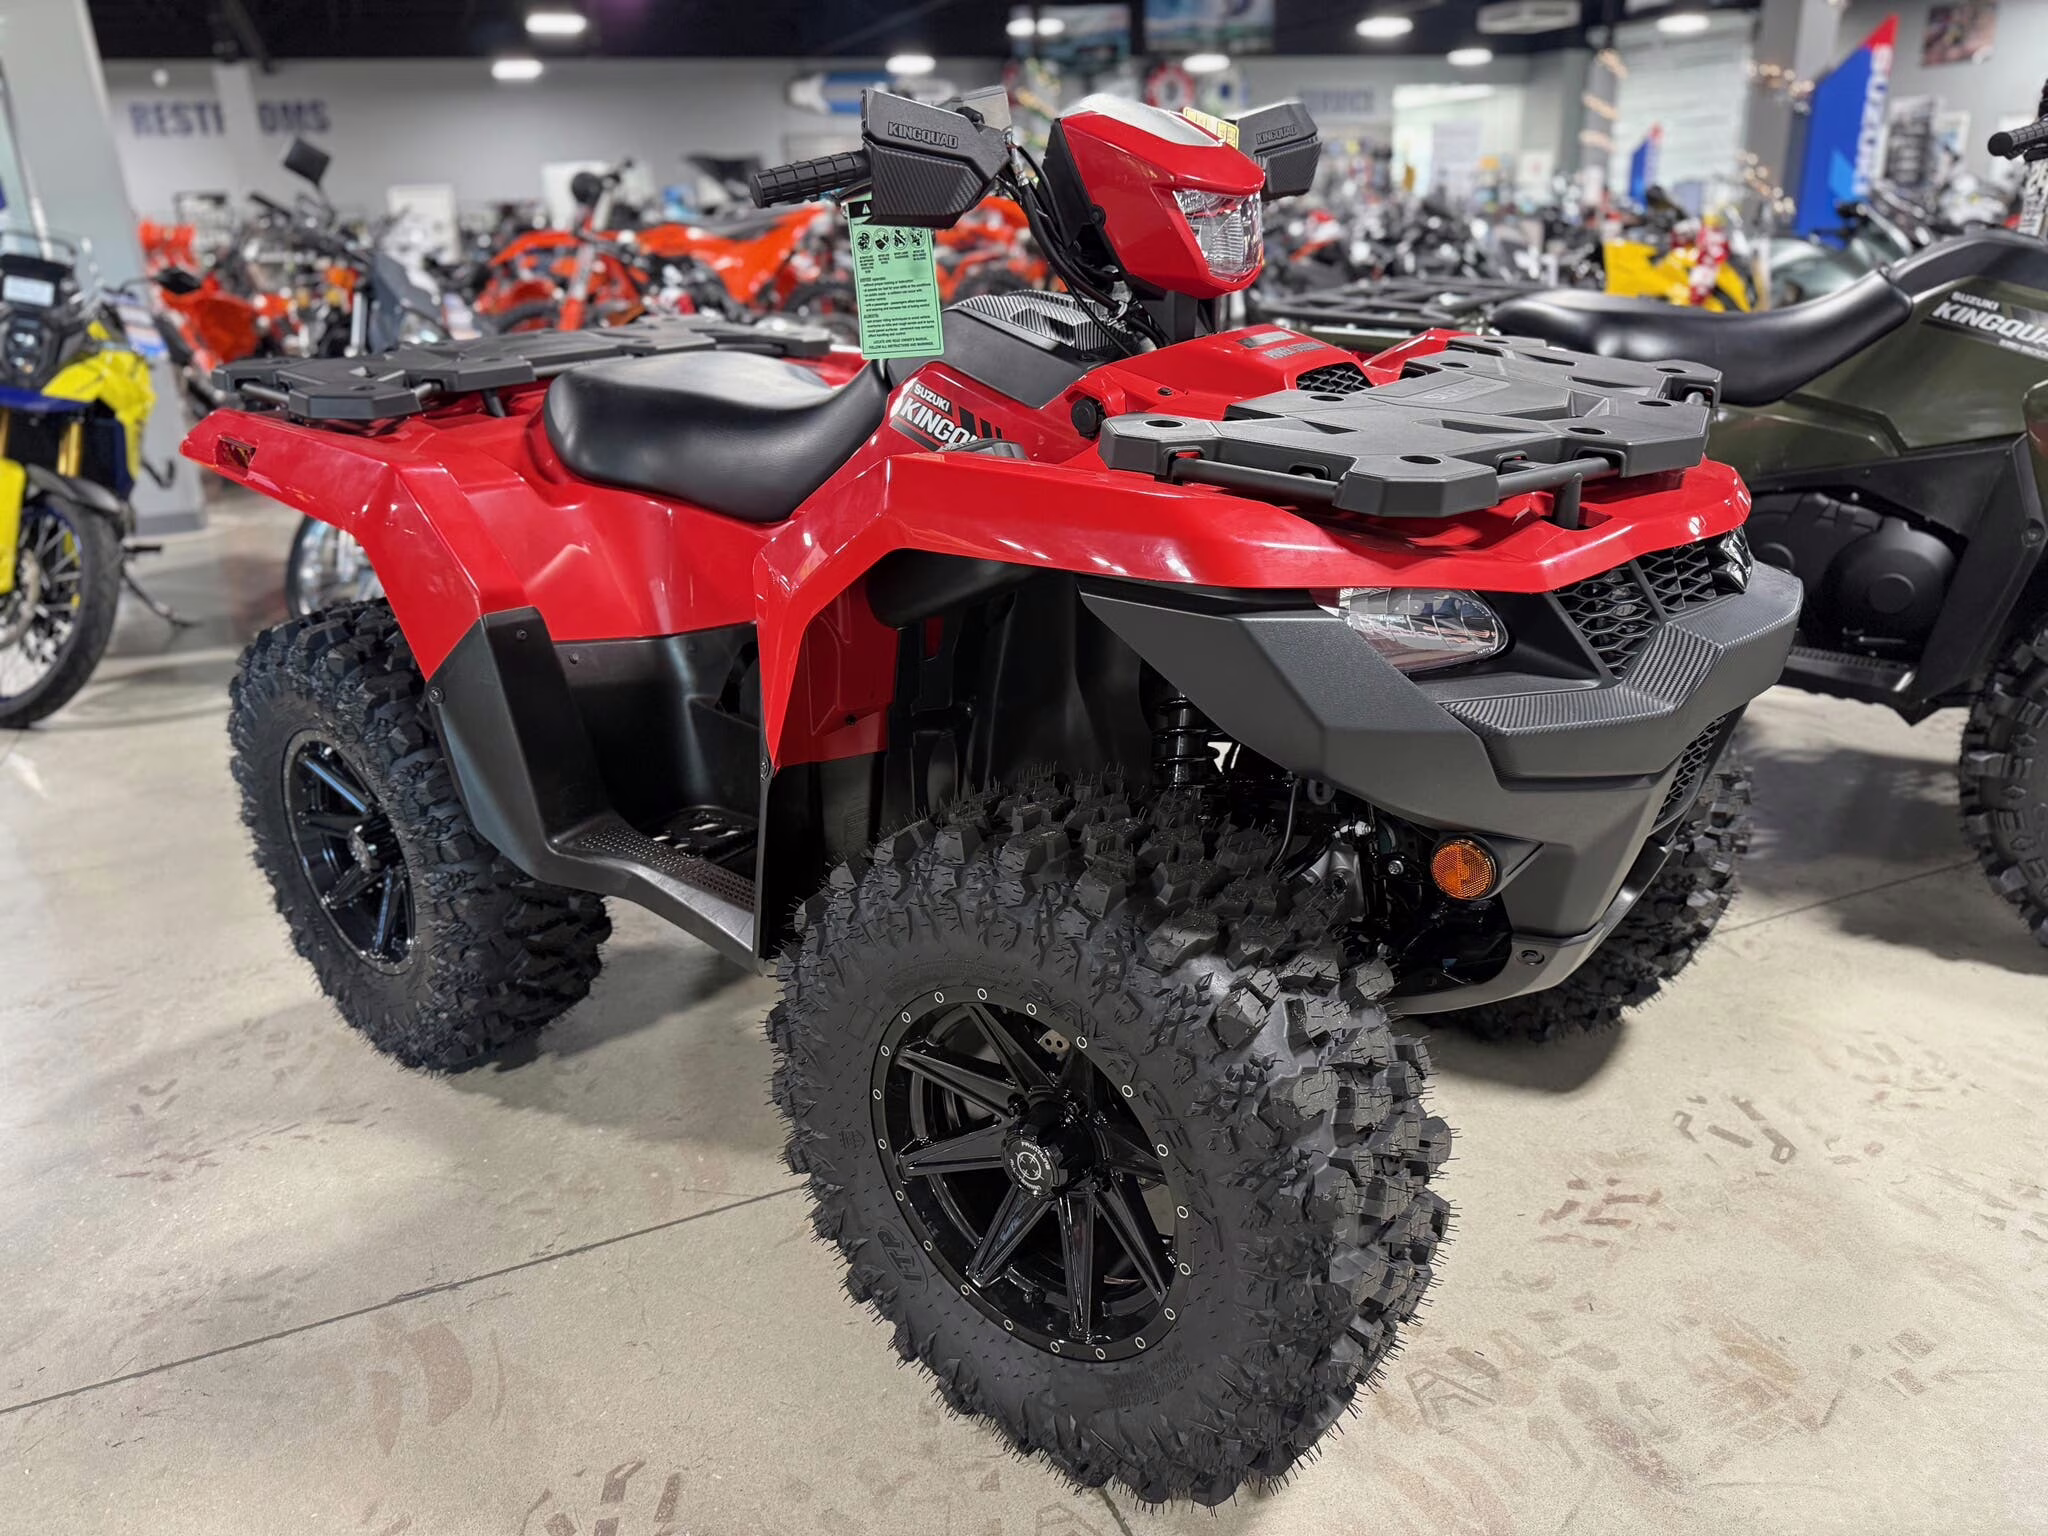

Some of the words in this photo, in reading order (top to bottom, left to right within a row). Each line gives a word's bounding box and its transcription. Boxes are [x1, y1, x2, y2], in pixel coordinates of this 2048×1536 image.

[888, 121, 959, 149] KINGQUAD
[1256, 124, 1298, 145] KINGQUAD
[1951, 291, 2000, 311] SUZUKI
[914, 384, 950, 412] SUZUKI
[901, 398, 978, 444] KINGQ
[877, 1230, 924, 1283] ITP
